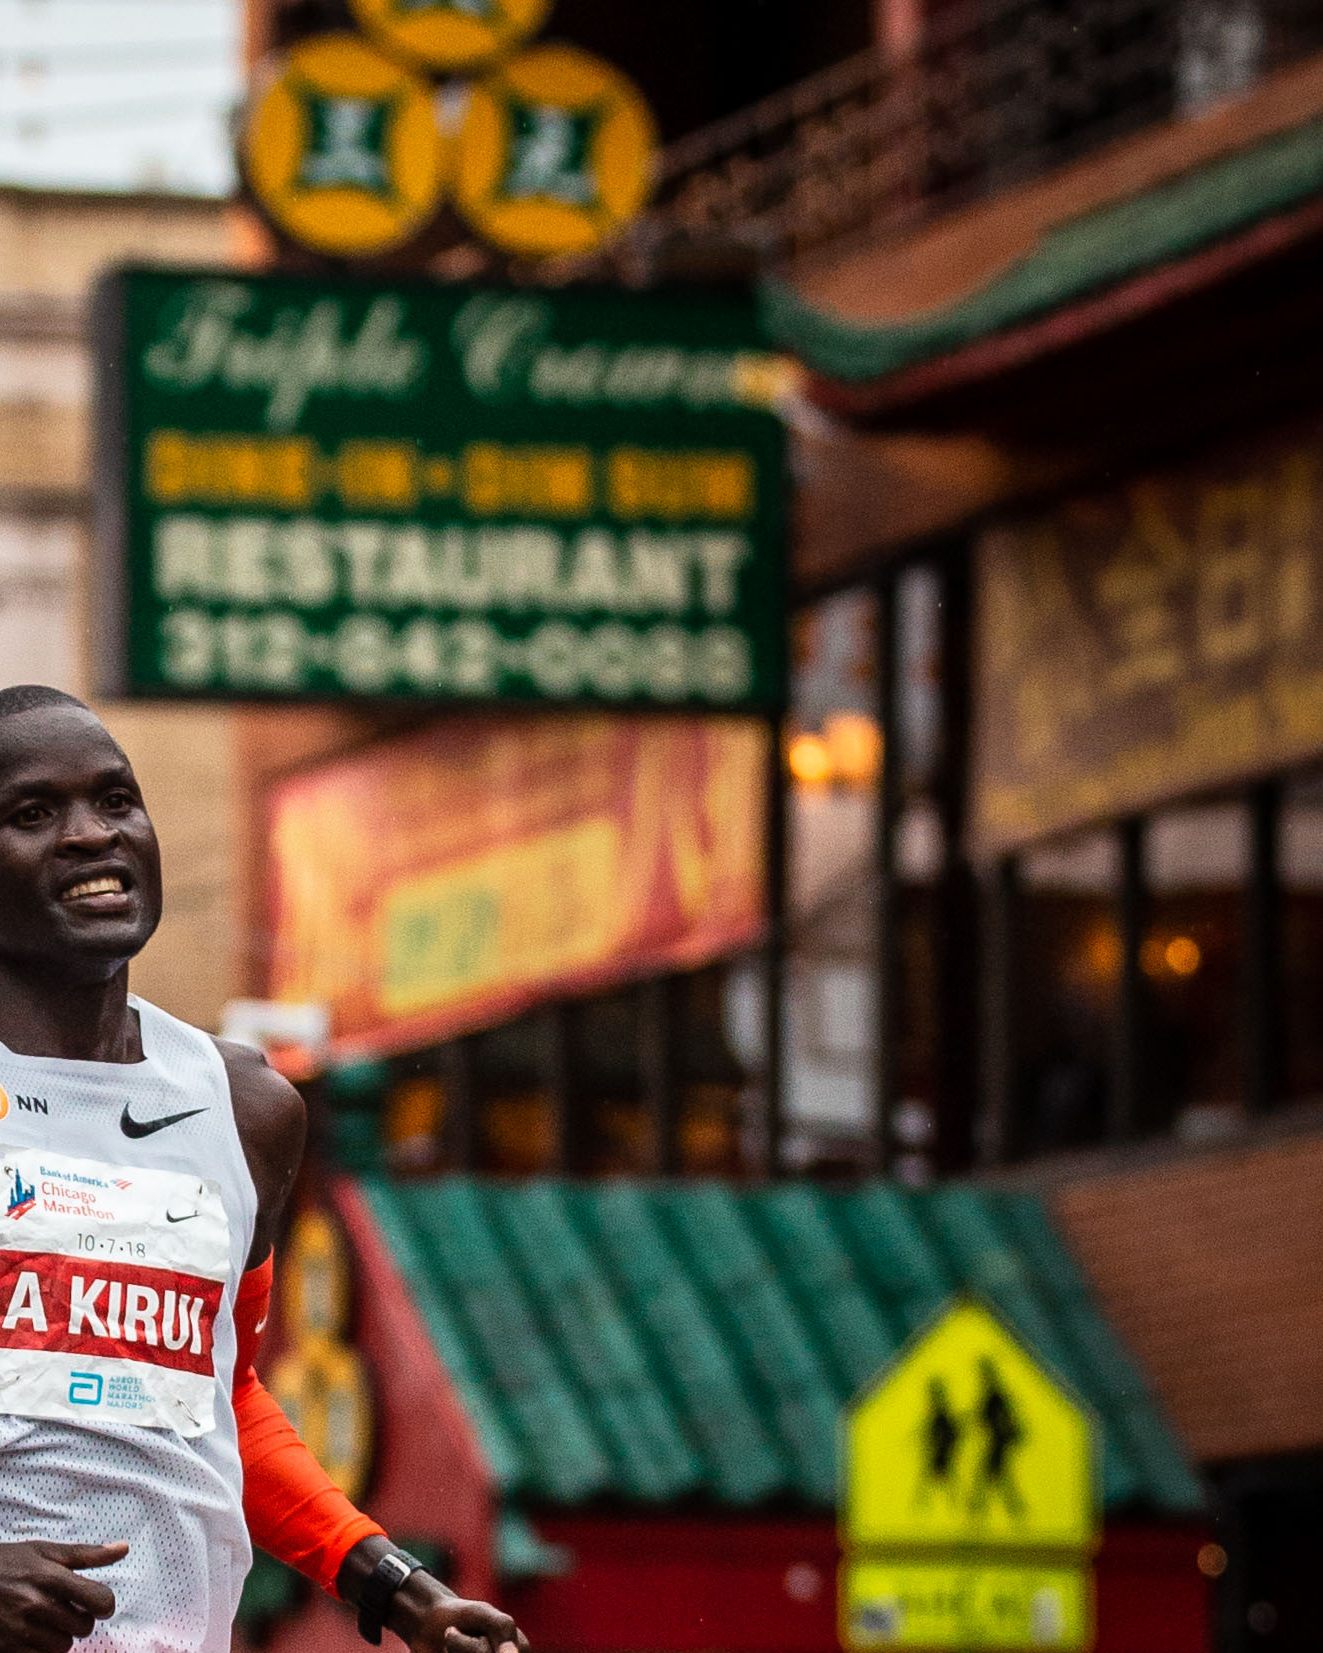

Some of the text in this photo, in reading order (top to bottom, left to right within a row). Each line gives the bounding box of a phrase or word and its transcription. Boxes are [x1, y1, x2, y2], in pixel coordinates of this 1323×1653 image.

[152, 516, 750, 612] RESTAURANT
[15, 1094, 48, 1115] NN
[41, 1181, 96, 1204] Chicago
[43, 1199, 115, 1220] Marathon
[2, 1271, 204, 1355] A KIRUI
